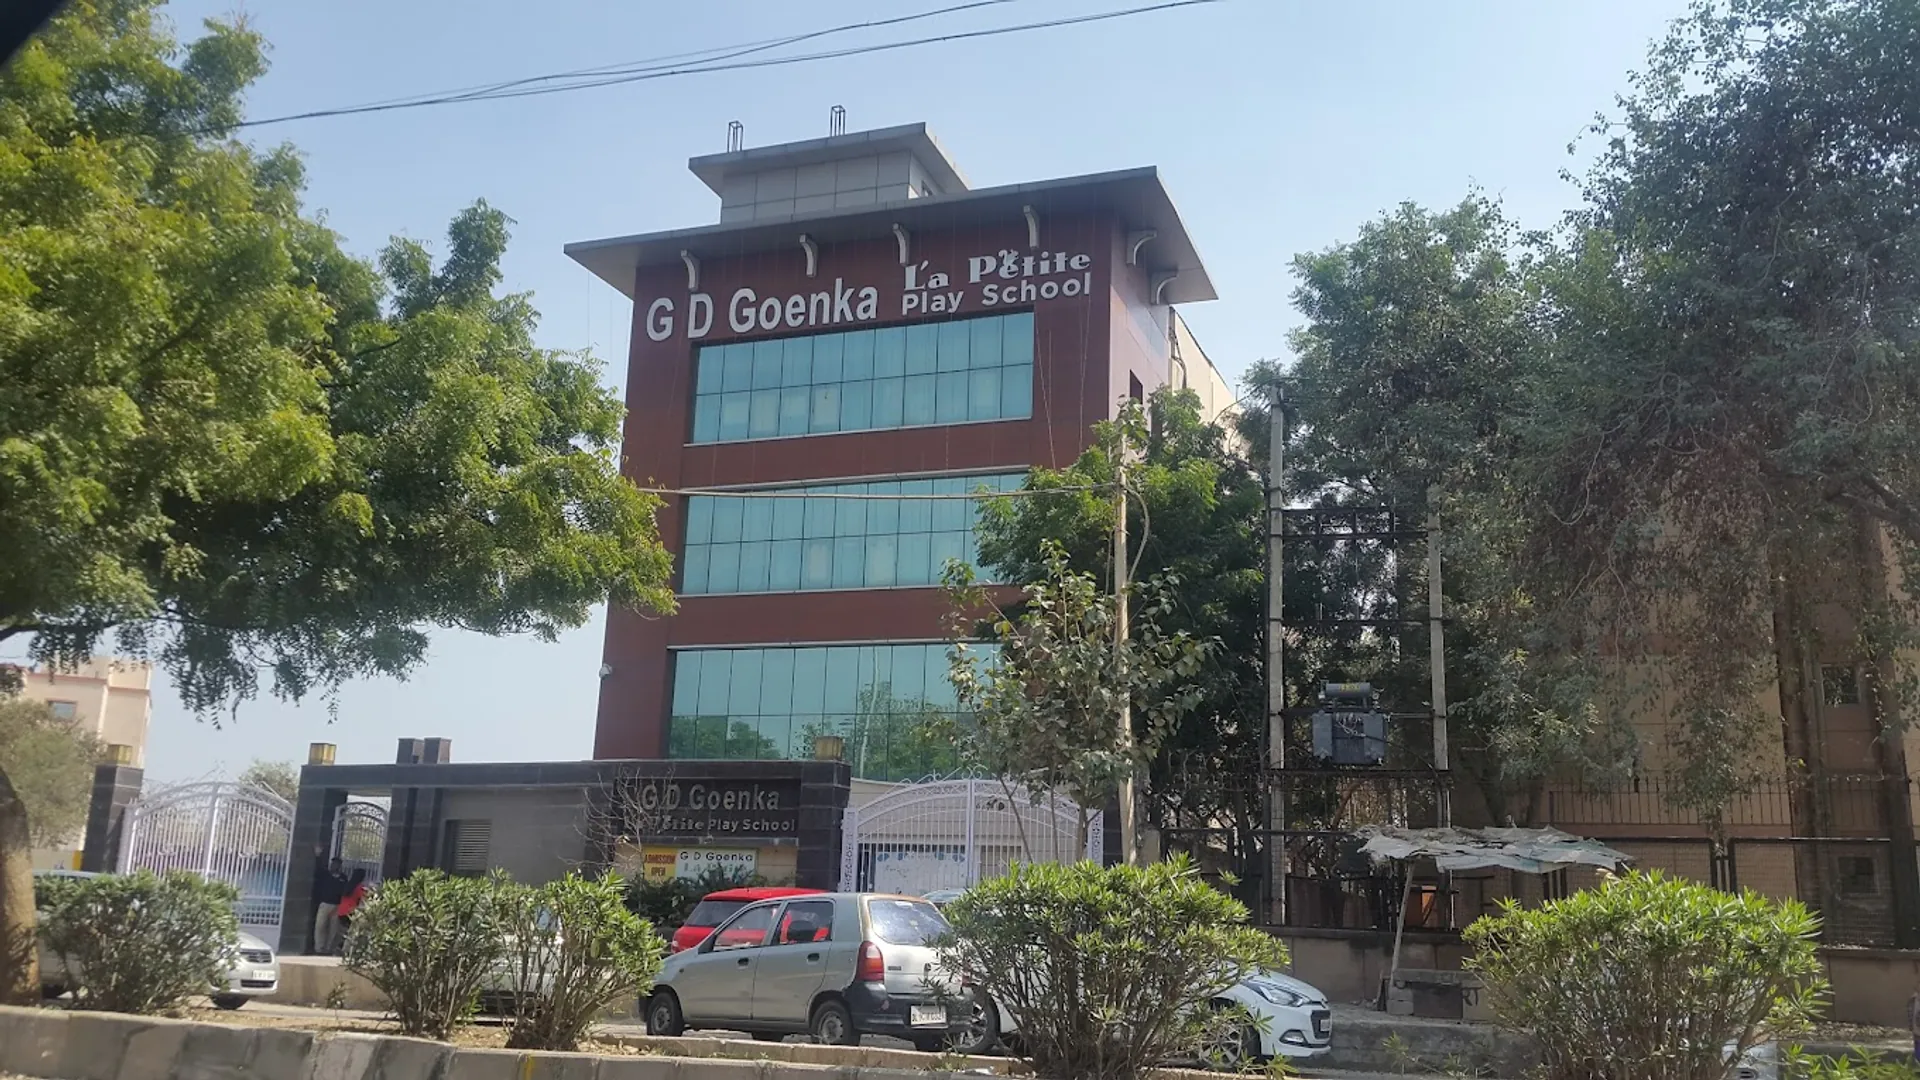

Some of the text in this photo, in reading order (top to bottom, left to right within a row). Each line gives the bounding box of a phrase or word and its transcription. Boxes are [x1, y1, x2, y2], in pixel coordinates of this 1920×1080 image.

[902, 272, 1091, 316] Play School
[646, 277, 878, 341] G D Goenka
[642, 784, 780, 810] G D Goenka
[708, 818, 739, 832] Play
[742, 818, 795, 832] School
[680, 851, 753, 862] G D Goenka
